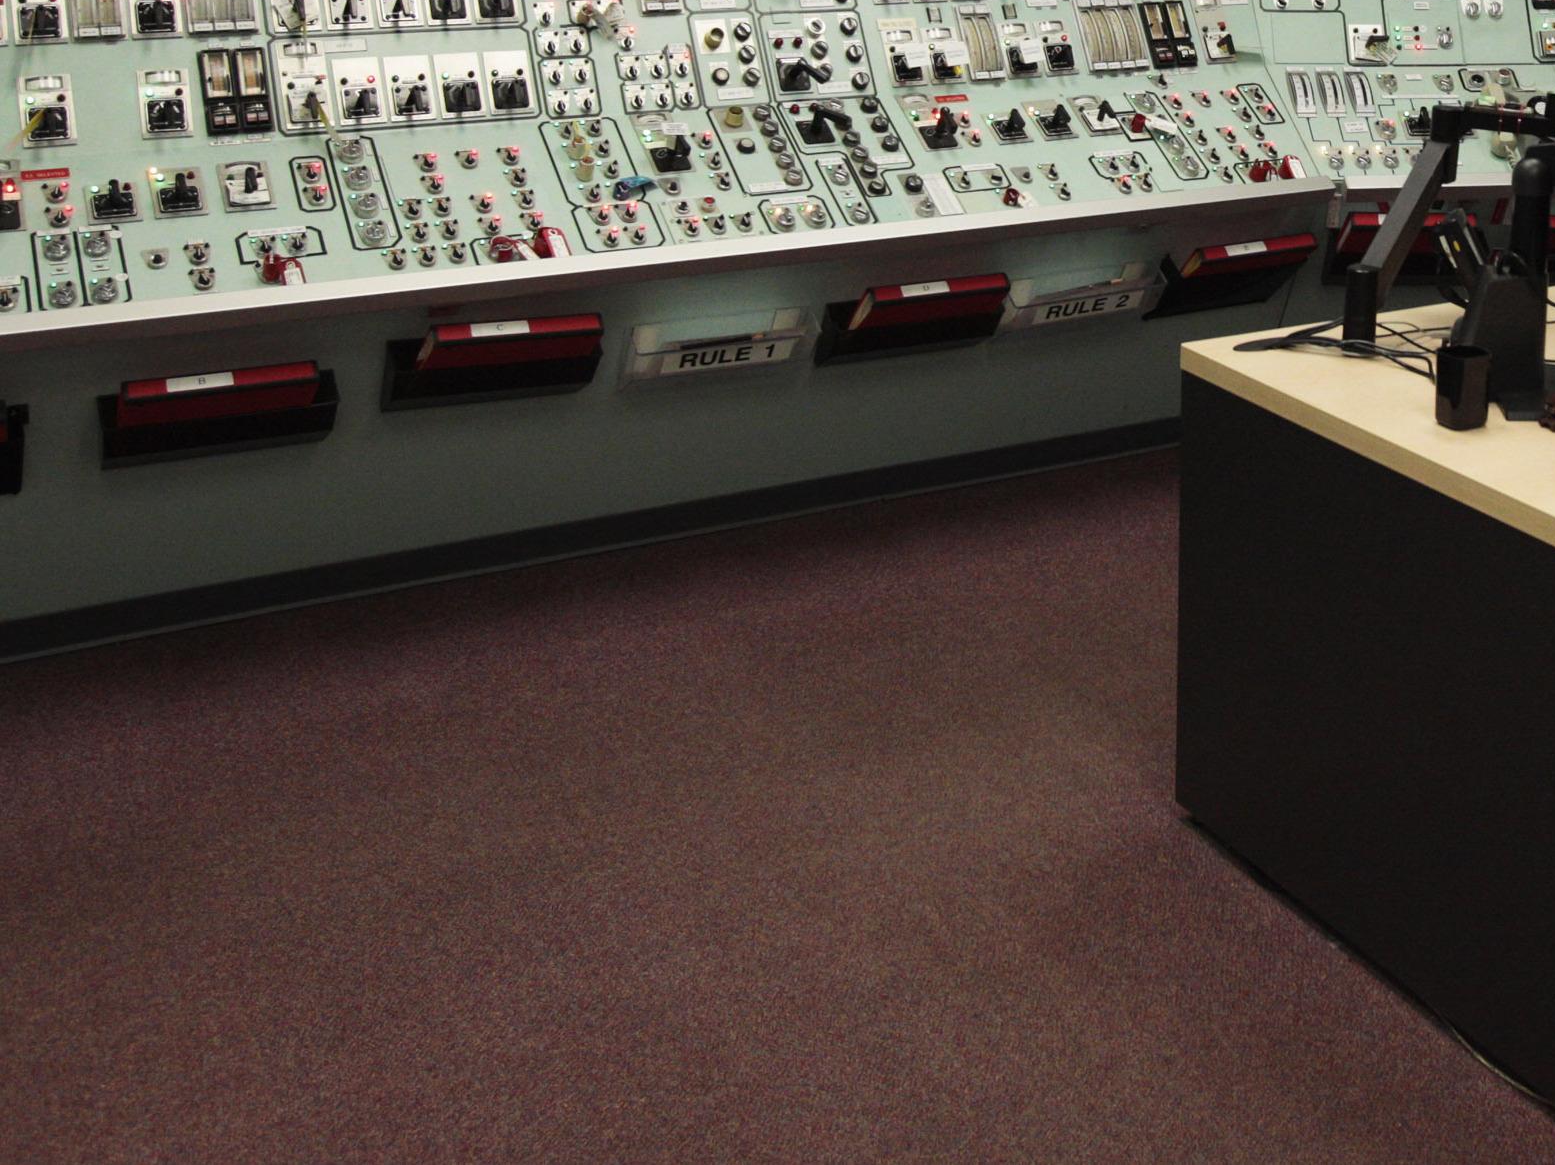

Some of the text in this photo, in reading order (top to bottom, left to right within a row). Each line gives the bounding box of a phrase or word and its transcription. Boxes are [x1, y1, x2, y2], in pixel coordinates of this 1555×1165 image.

[1046, 294, 1130, 319] RULE 2
[679, 343, 775, 369] RULE 1
